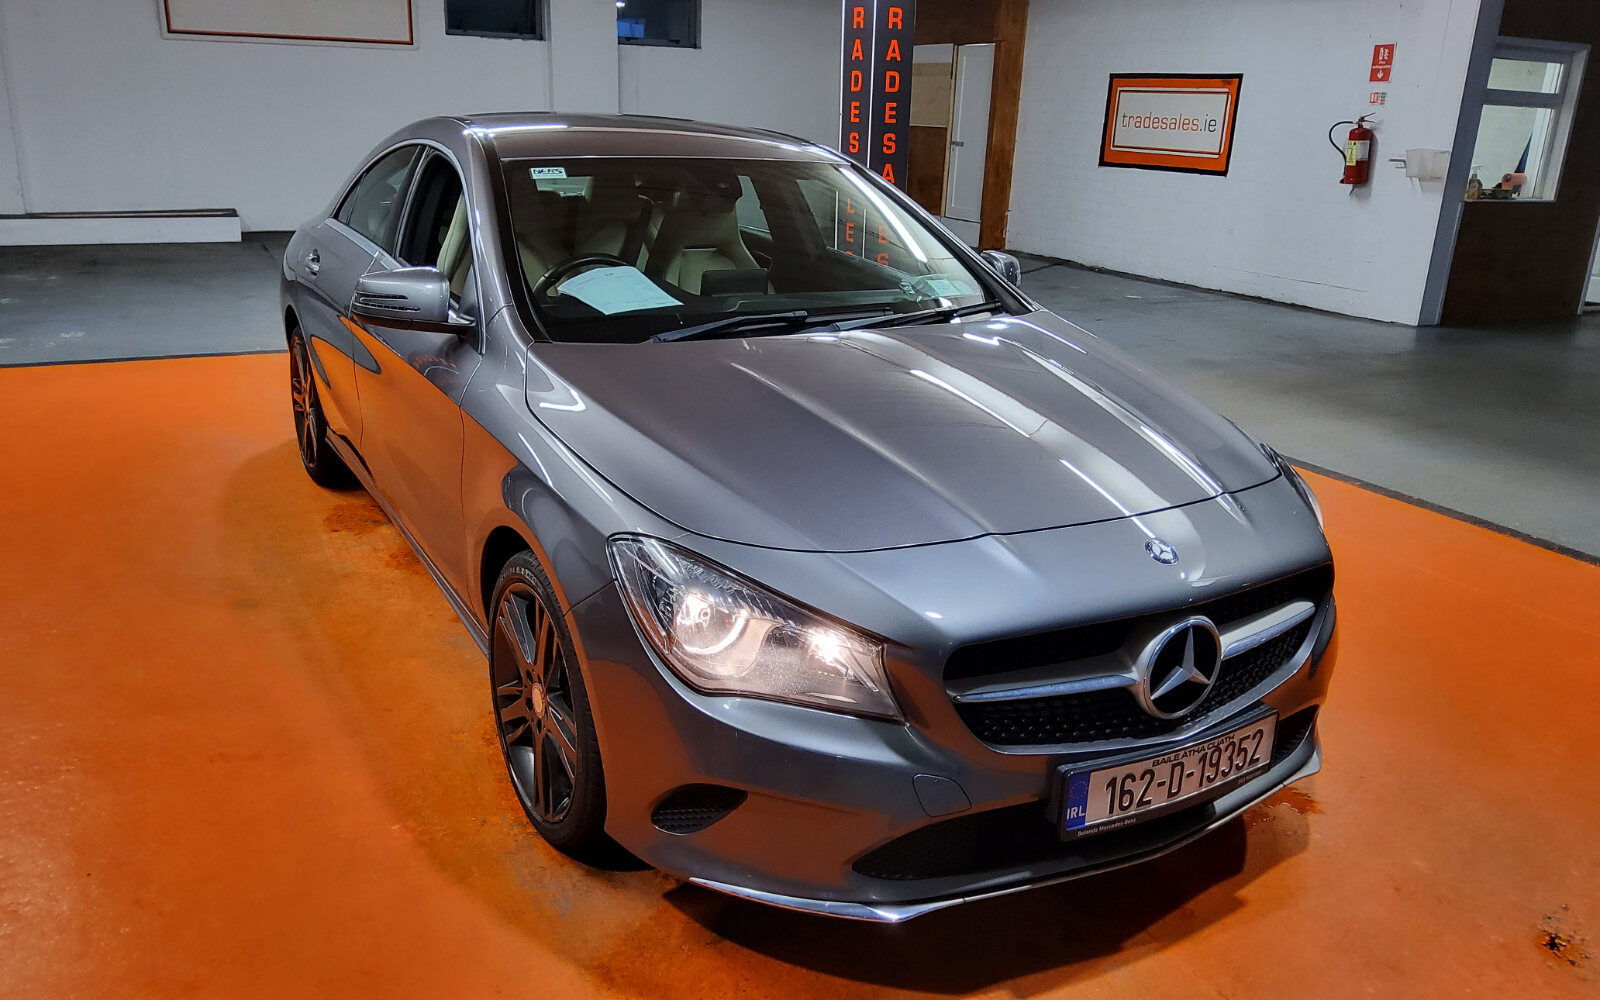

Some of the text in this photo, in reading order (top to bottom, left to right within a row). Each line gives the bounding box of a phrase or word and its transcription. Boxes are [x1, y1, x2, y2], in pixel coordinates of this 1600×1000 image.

[1122, 111, 1217, 133] tradesales.ie
[1152, 754, 1180, 767] BAILE
[1105, 728, 1264, 815] 162-D-19352
[1066, 805, 1086, 820] IRL
